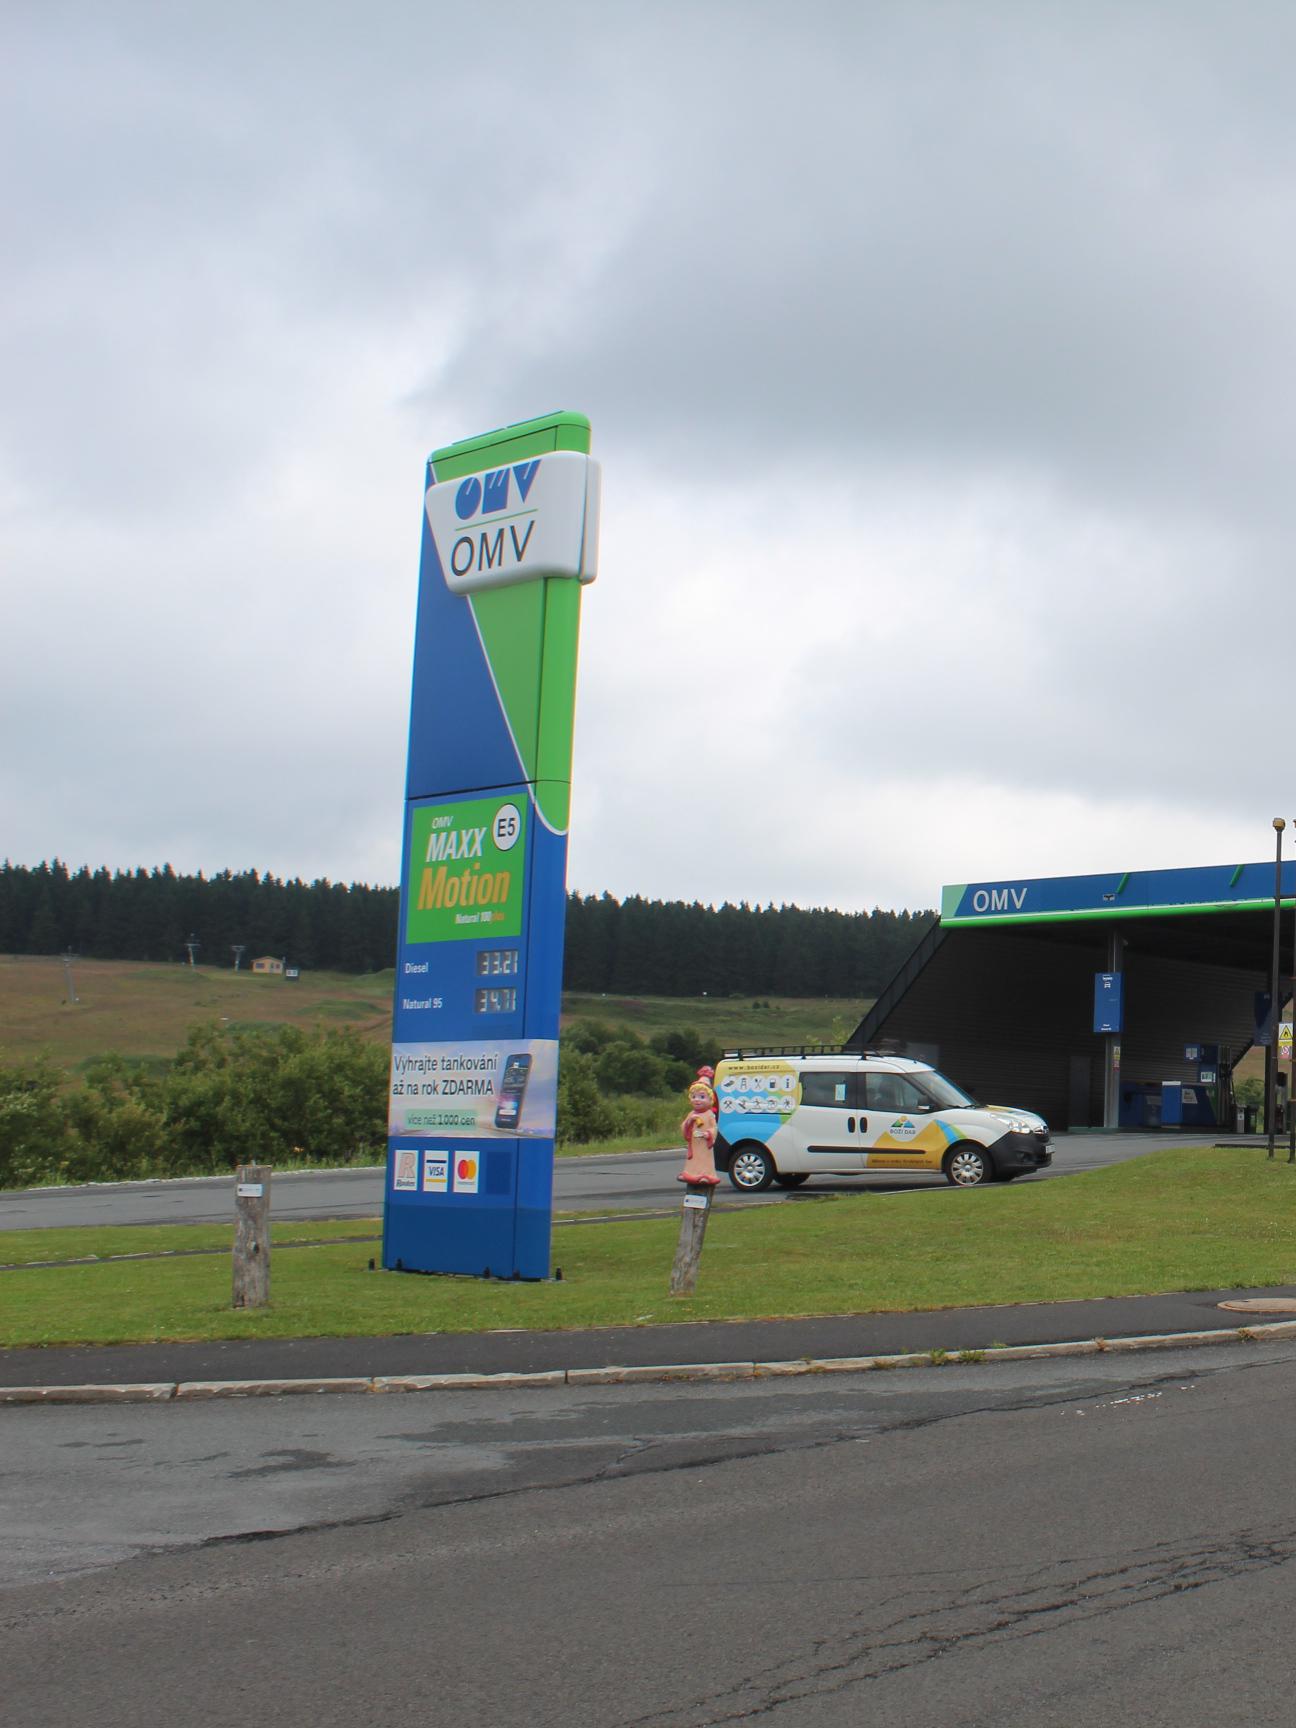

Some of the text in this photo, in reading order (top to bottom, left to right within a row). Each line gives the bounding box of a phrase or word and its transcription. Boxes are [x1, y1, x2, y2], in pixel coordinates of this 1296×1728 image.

[451, 520, 535, 576] OMV
[432, 816, 453, 829] OMV
[497, 817, 516, 837] E5
[425, 827, 487, 862] MAXX
[417, 862, 511, 910] Motion
[973, 888, 1027, 912] OMV
[455, 912, 480, 924] Natural
[405, 962, 429, 974] Diesel
[403, 998, 443, 1009] Natural 95
[394, 1054, 498, 1075] Vyhrajte tankování
[392, 1079, 494, 1096] až na rok ZDARMA
[438, 1114, 459, 1125] 1000
[460, 1117, 475, 1126] cen
[428, 1166, 445, 1176] VISA
